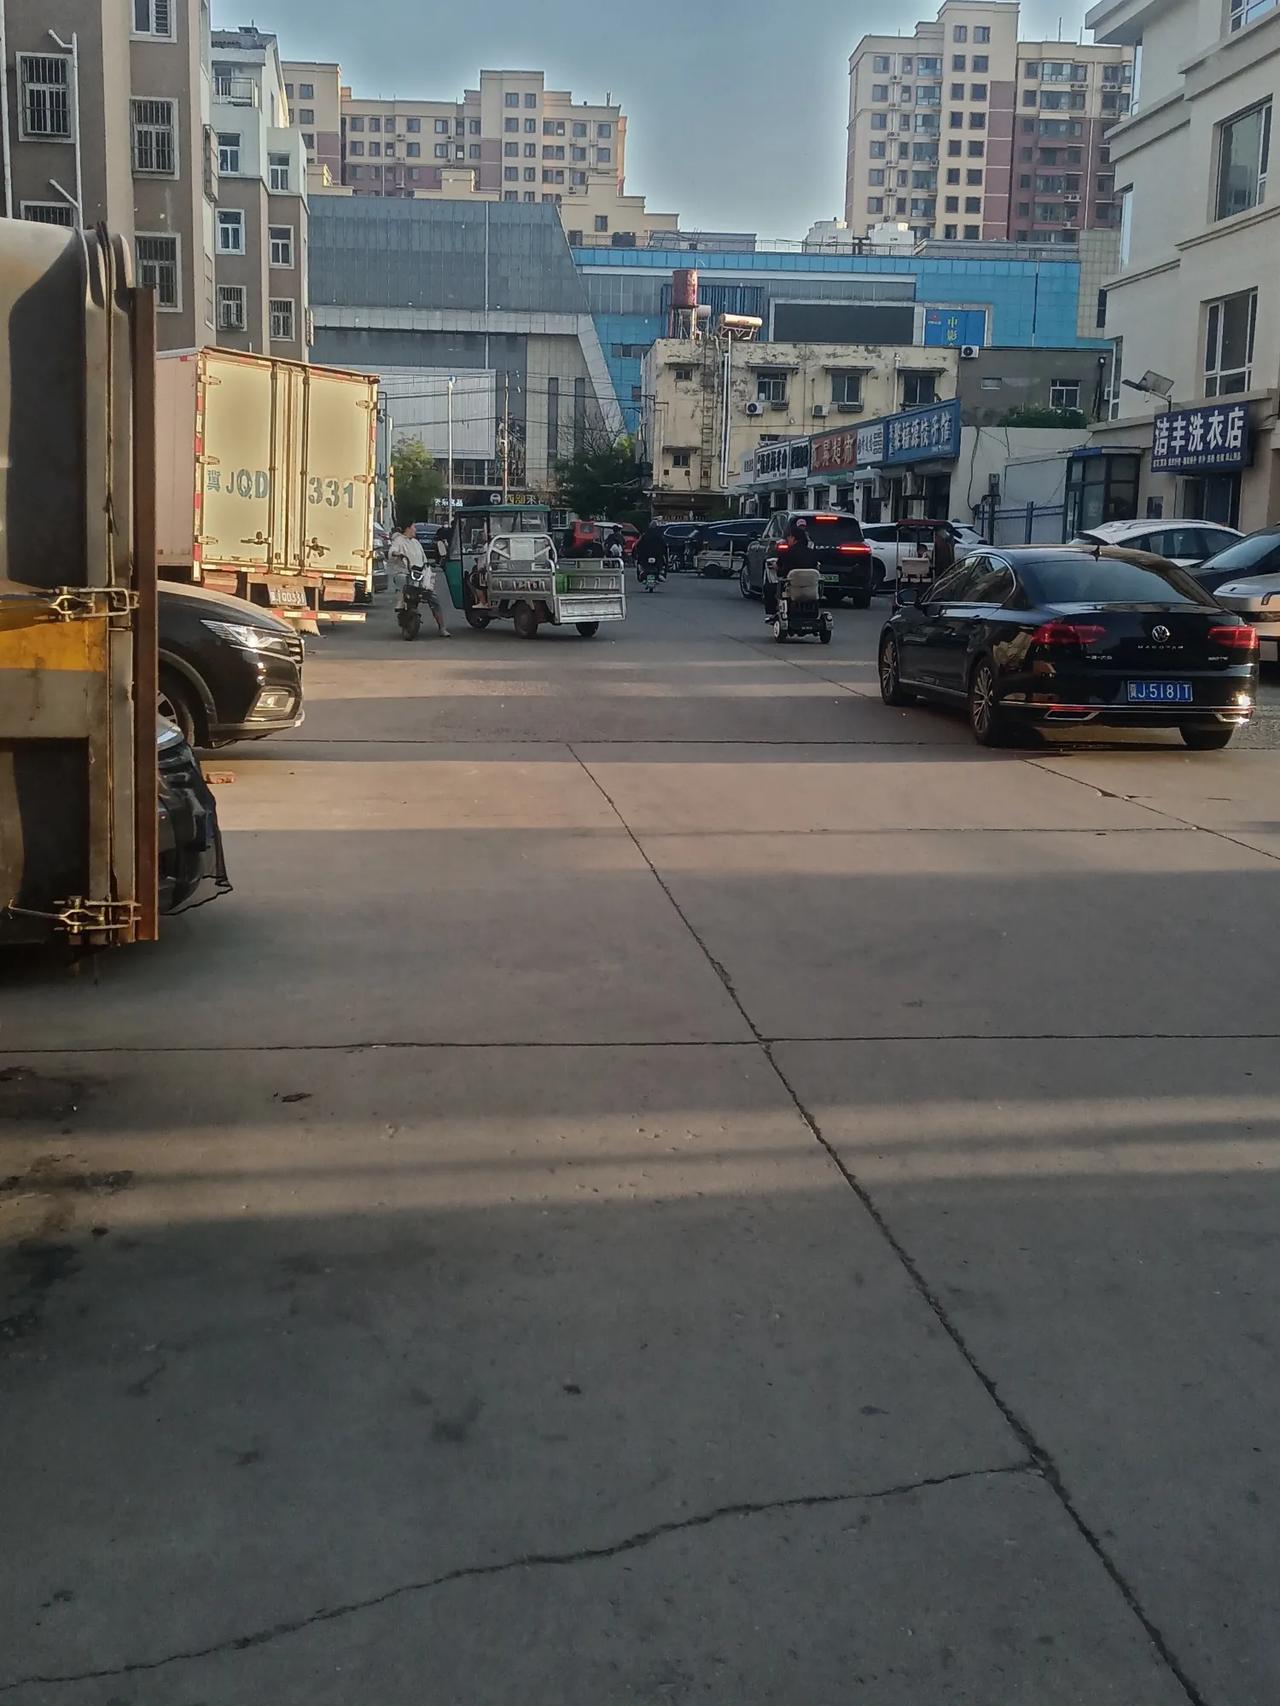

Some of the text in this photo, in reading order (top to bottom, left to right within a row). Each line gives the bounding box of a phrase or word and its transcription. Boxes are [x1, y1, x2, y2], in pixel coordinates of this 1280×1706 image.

[1154, 406, 1244, 456] 洁丰洗衣店
[308, 477, 353, 509] 331
